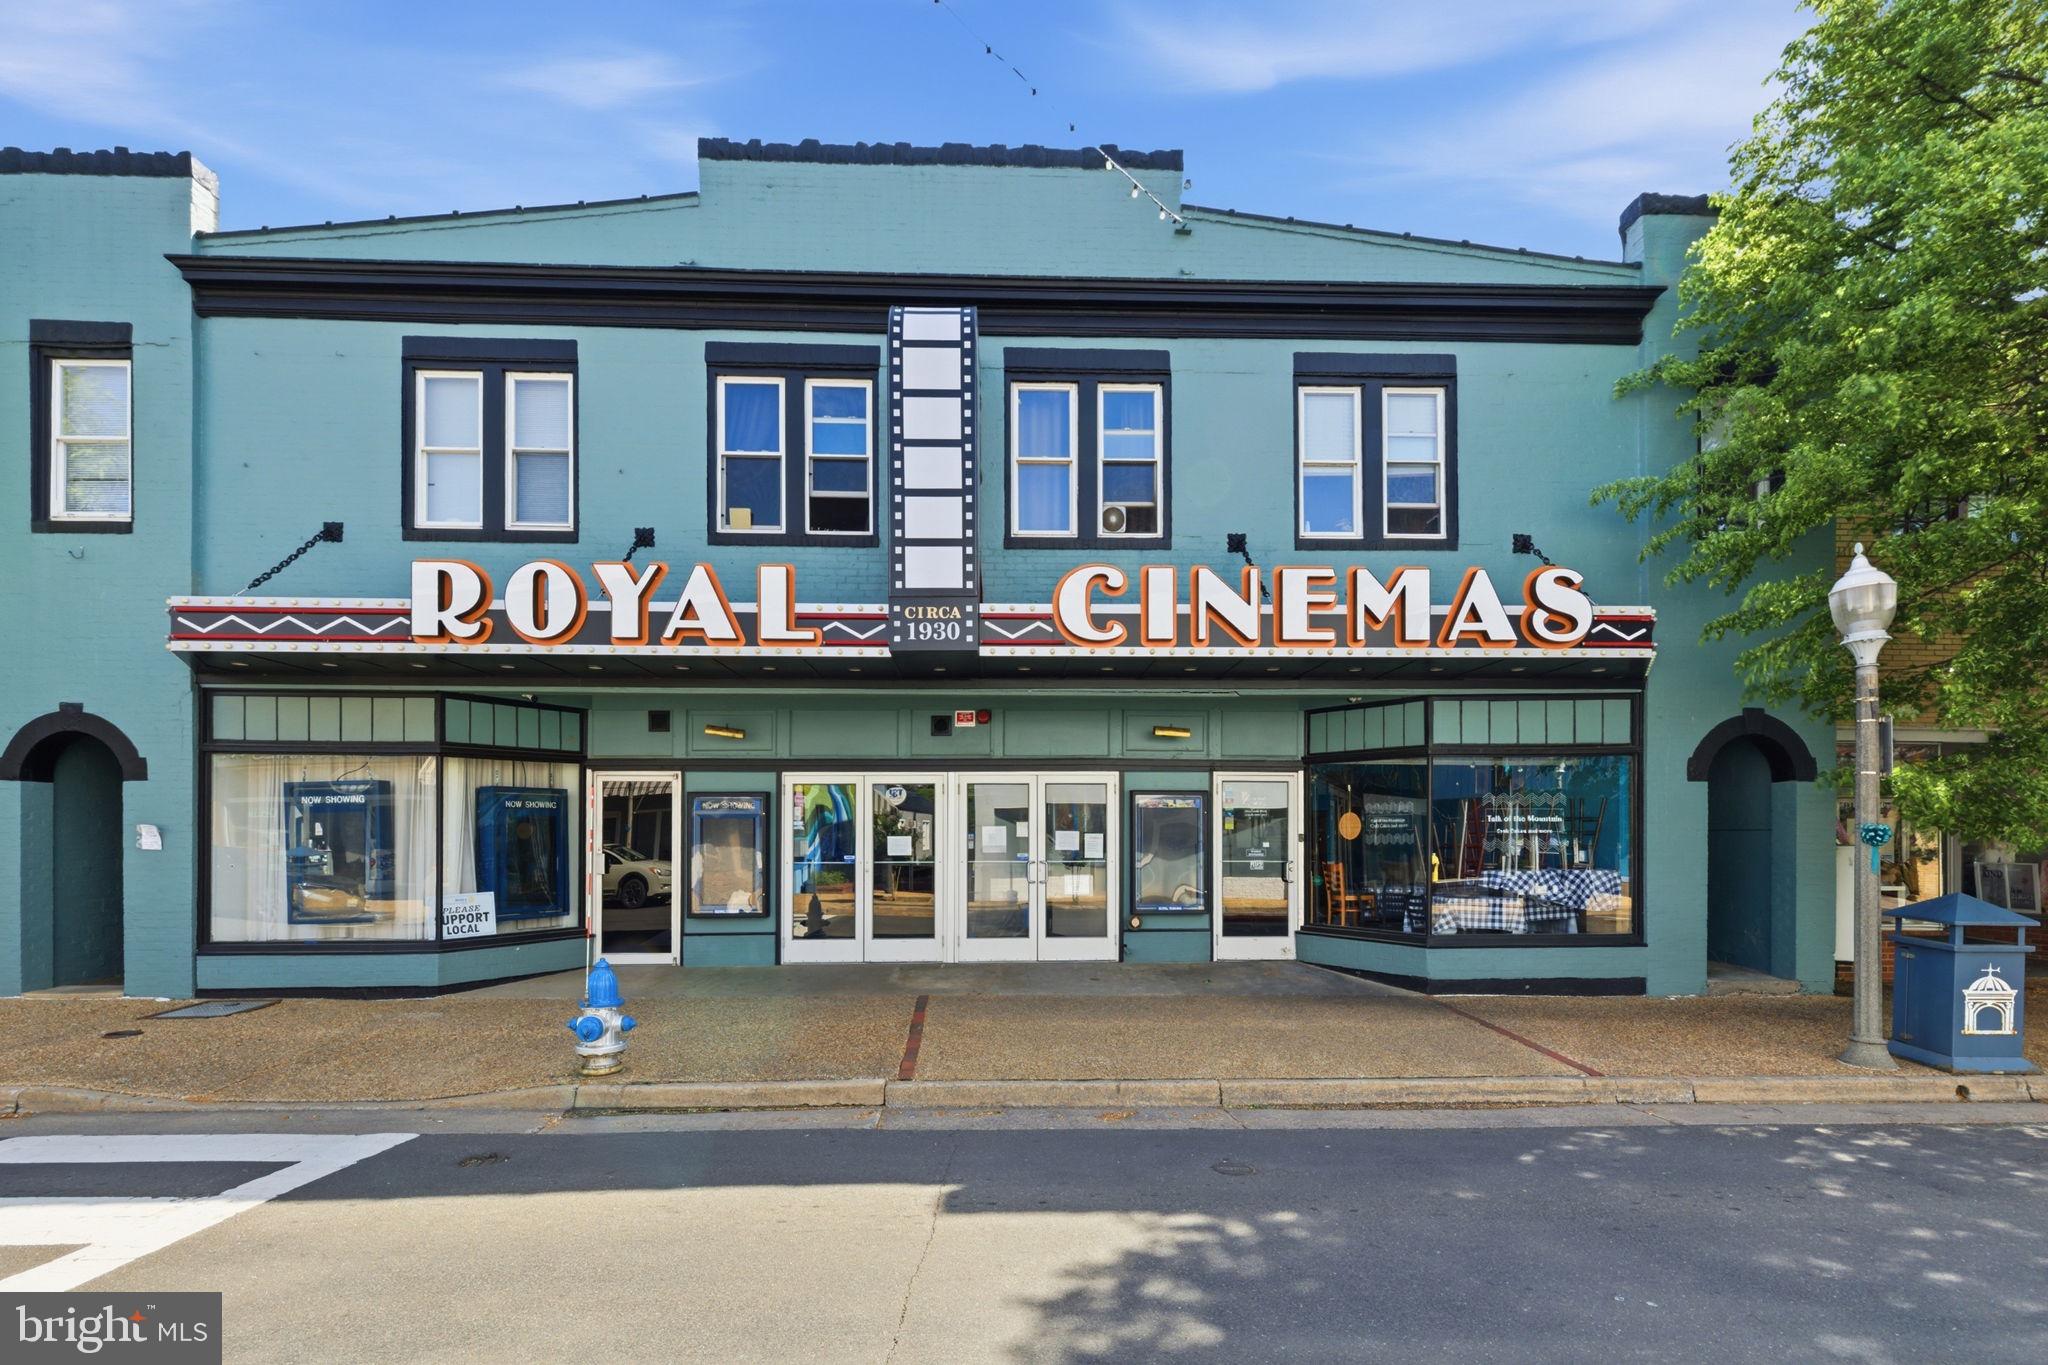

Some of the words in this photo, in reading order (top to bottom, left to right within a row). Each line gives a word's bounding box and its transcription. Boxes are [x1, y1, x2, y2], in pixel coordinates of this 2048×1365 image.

[411, 559, 821, 645] ROYAL
[1053, 563, 1594, 648] CINEMAS
[904, 606, 962, 619] CIRCA
[907, 621, 960, 640] 1930
[301, 796, 322, 804] NOW
[325, 794, 366, 804] SHOWING
[505, 800, 522, 808] NOW
[525, 801, 557, 809] SHOWING
[702, 801, 720, 810] NOW
[443, 905, 481, 914] PLEASE
[442, 912, 490, 925] UPPORT
[447, 924, 480, 935] LOCAL
